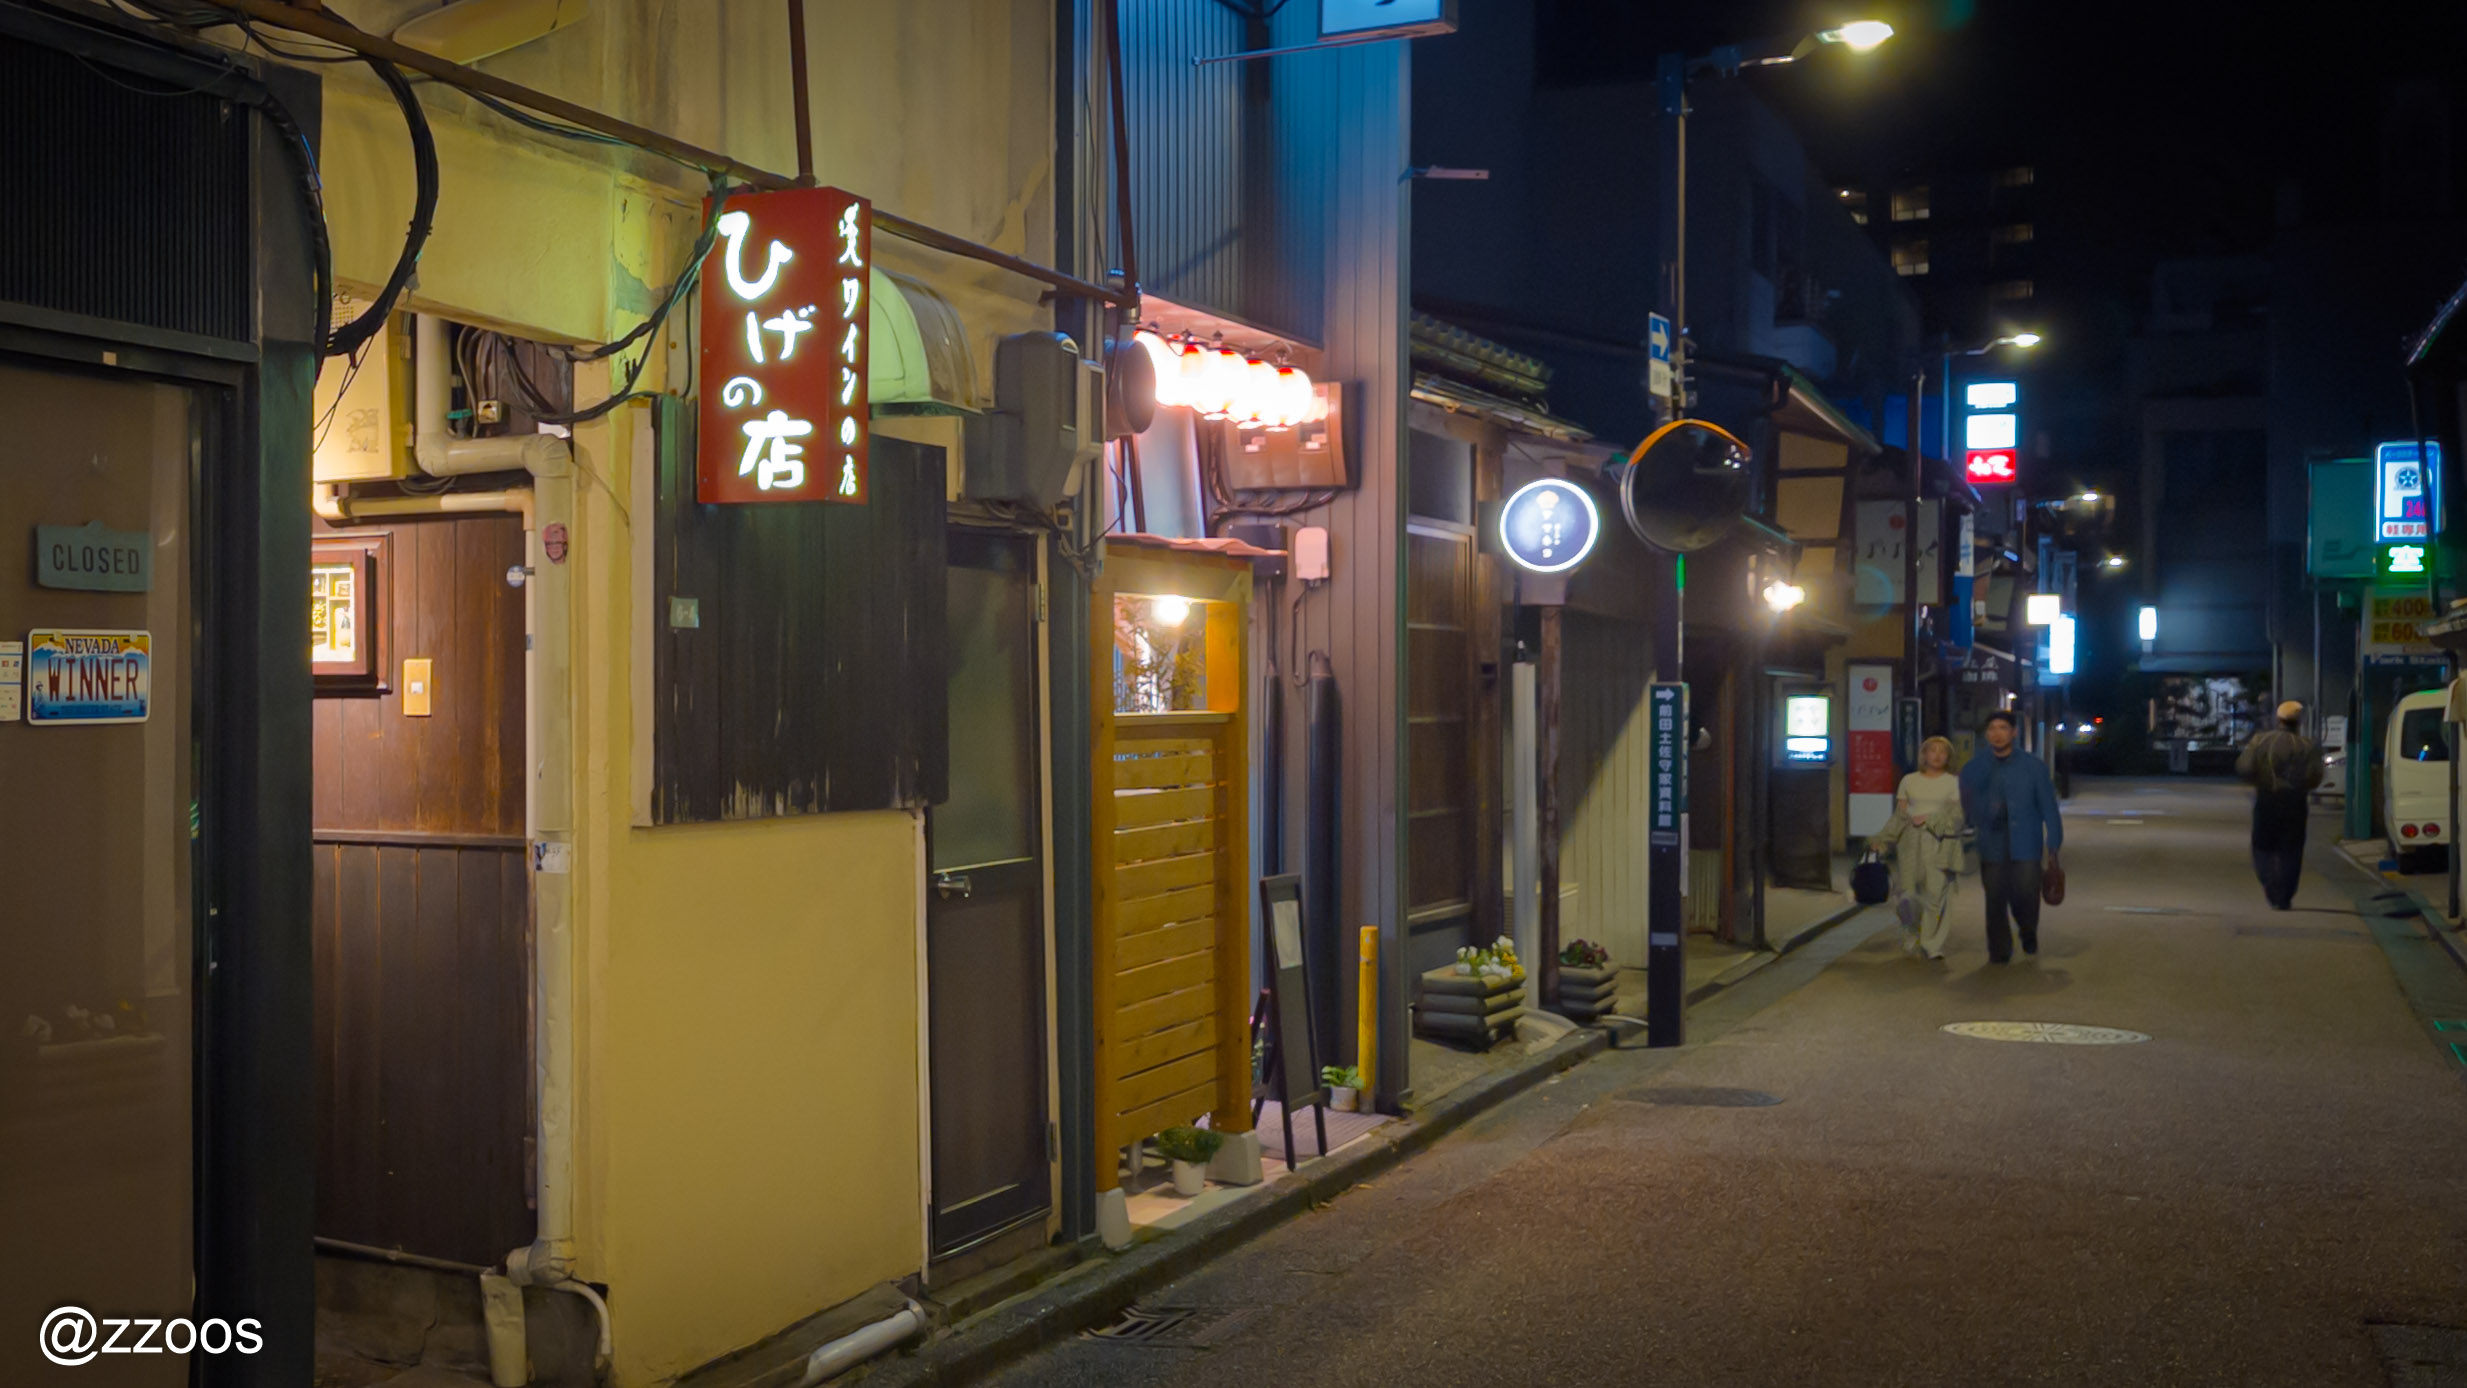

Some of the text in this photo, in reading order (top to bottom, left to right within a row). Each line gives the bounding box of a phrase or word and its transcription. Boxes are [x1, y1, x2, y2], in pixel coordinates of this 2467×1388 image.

[716, 210, 817, 491] ひげの店
[52, 543, 140, 575] CLOSED
[65, 638, 120, 654] NEVADA
[48, 658, 139, 702] WINNER
